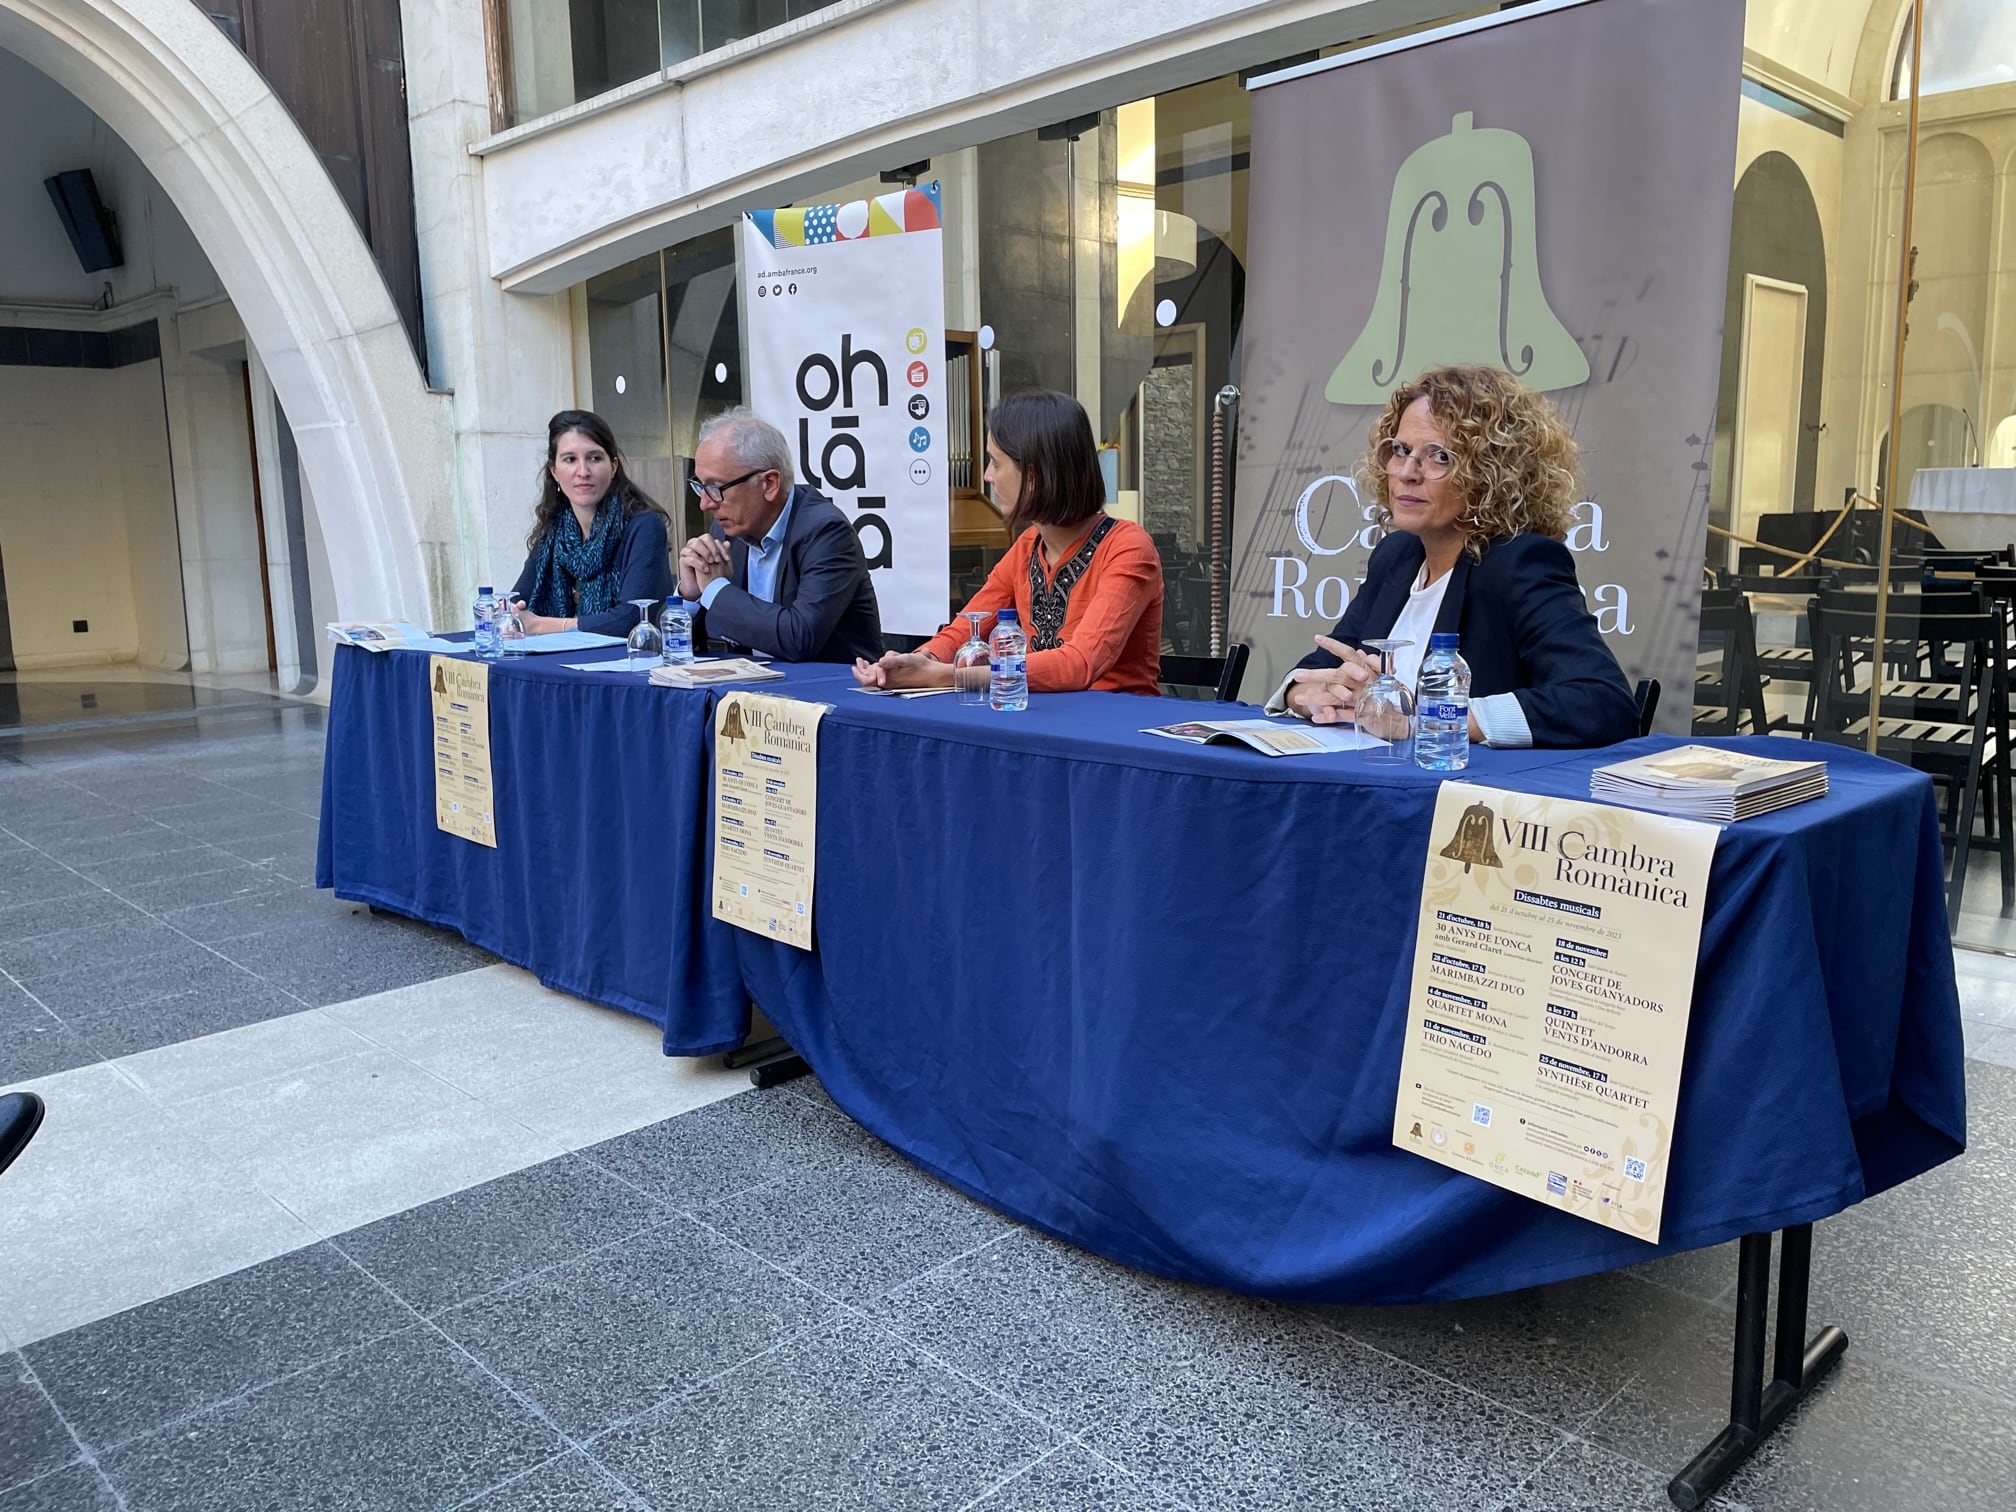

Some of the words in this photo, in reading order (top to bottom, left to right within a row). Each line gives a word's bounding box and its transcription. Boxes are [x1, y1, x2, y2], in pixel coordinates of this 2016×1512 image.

[758, 266, 818, 278] ad.ambafrance.org
[796, 333, 889, 412] oh
[744, 708, 761, 728] VIII
[764, 712, 805, 736] Cambra
[1500, 818, 1552, 853] VIII
[1557, 831, 1676, 878] Cambra
[1554, 857, 1689, 909] Romànica
[1516, 891, 1558, 908] Dissabtes
[1560, 901, 1600, 918] musicals
[1446, 912, 1476, 927] d'octubre,
[1509, 908, 1538, 920] d'octubre
[1565, 921, 1595, 934] novembre
[1597, 928, 1605, 936] de
[1435, 933, 1450, 942] amb
[1452, 936, 1478, 949] Gerard
[1479, 943, 1502, 955] Claret
[1436, 923, 1447, 932] 30
[1448, 925, 1476, 939] ANYS
[1478, 932, 1493, 943] DE
[1494, 936, 1532, 953] L'ONCA
[1566, 941, 1575, 949] de
[1575, 944, 1607, 957] novembre
[1433, 953, 1440, 961] 28
[1441, 954, 1471, 969] d'octubre,
[1480, 965, 1484, 973] h
[1560, 954, 1570, 963] les
[1570, 956, 1579, 965] 12
[1579, 958, 1584, 966] h
[1430, 964, 1498, 989] MARIMBAZZI
[1500, 980, 1525, 996] DUO
[1552, 964, 1605, 985] CONCERT
[1607, 978, 1622, 991] DE
[1442, 991, 1472, 1006] novembre,
[1551, 975, 1583, 991] JOVES
[1585, 984, 1664, 1013] GUANYADORS
[1426, 998, 1474, 1018] QUARTET
[1475, 1012, 1507, 1028] MONA
[1553, 1005, 1562, 1014] les
[1571, 1011, 1576, 1019] h
[1432, 1022, 1440, 1030] de
[1441, 1025, 1471, 1040] novembre,
[1480, 1035, 1485, 1043] h
[1545, 1016, 1595, 1037] QUINTET
[1423, 1031, 1447, 1045] TRIO
[1449, 1038, 1492, 1059] NACEDO
[1544, 1026, 1579, 1044] VENTS
[1581, 1038, 1648, 1066] D'ANDORRA
[1540, 1055, 1548, 1063] 25
[1549, 1057, 1558, 1066] de
[1558, 1061, 1591, 1078] novembre,
[1592, 1071, 1600, 1080] 17
[1600, 1073, 1606, 1082] h
[1595, 1084, 1649, 1109] QUARTET
